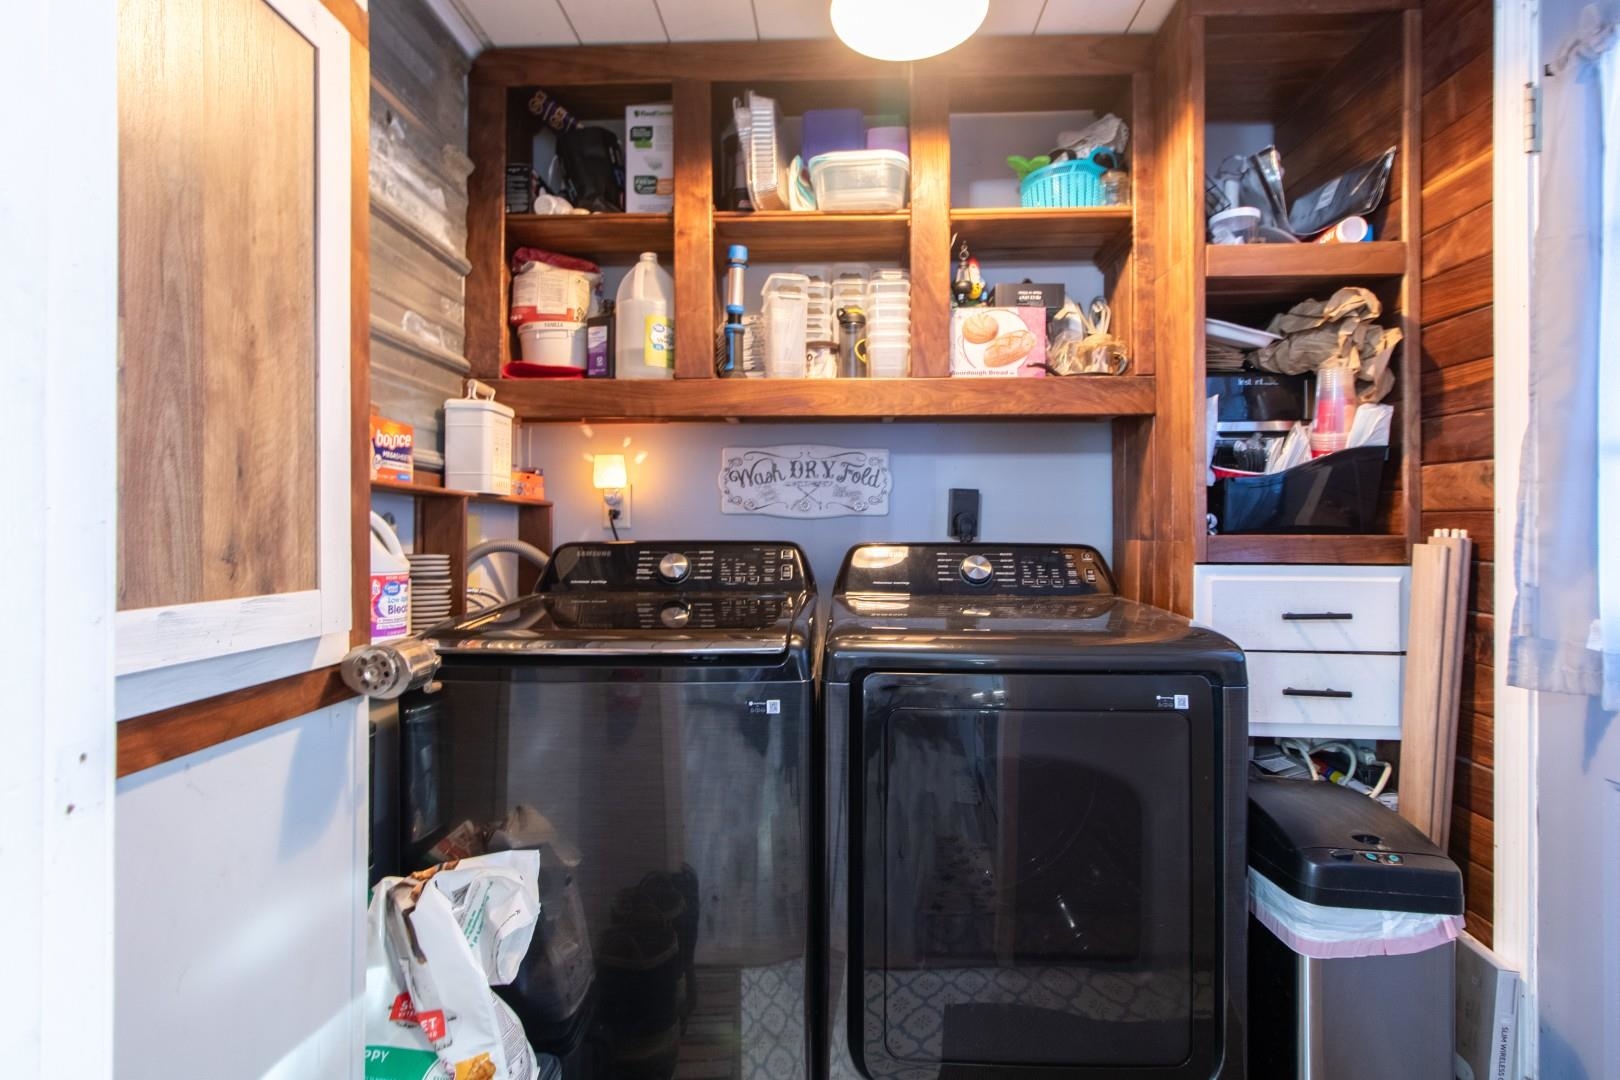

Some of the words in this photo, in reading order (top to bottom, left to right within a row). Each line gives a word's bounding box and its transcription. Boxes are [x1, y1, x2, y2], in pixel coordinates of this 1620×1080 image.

[376, 428, 412, 450] bounce
[728, 458, 785, 488] Wash
[789, 460, 835, 480] DRY
[837, 461, 881, 488] Fold
[1501, 1026, 1509, 1043] SLIM
[1498, 1043, 1507, 1077] WIRELESS
